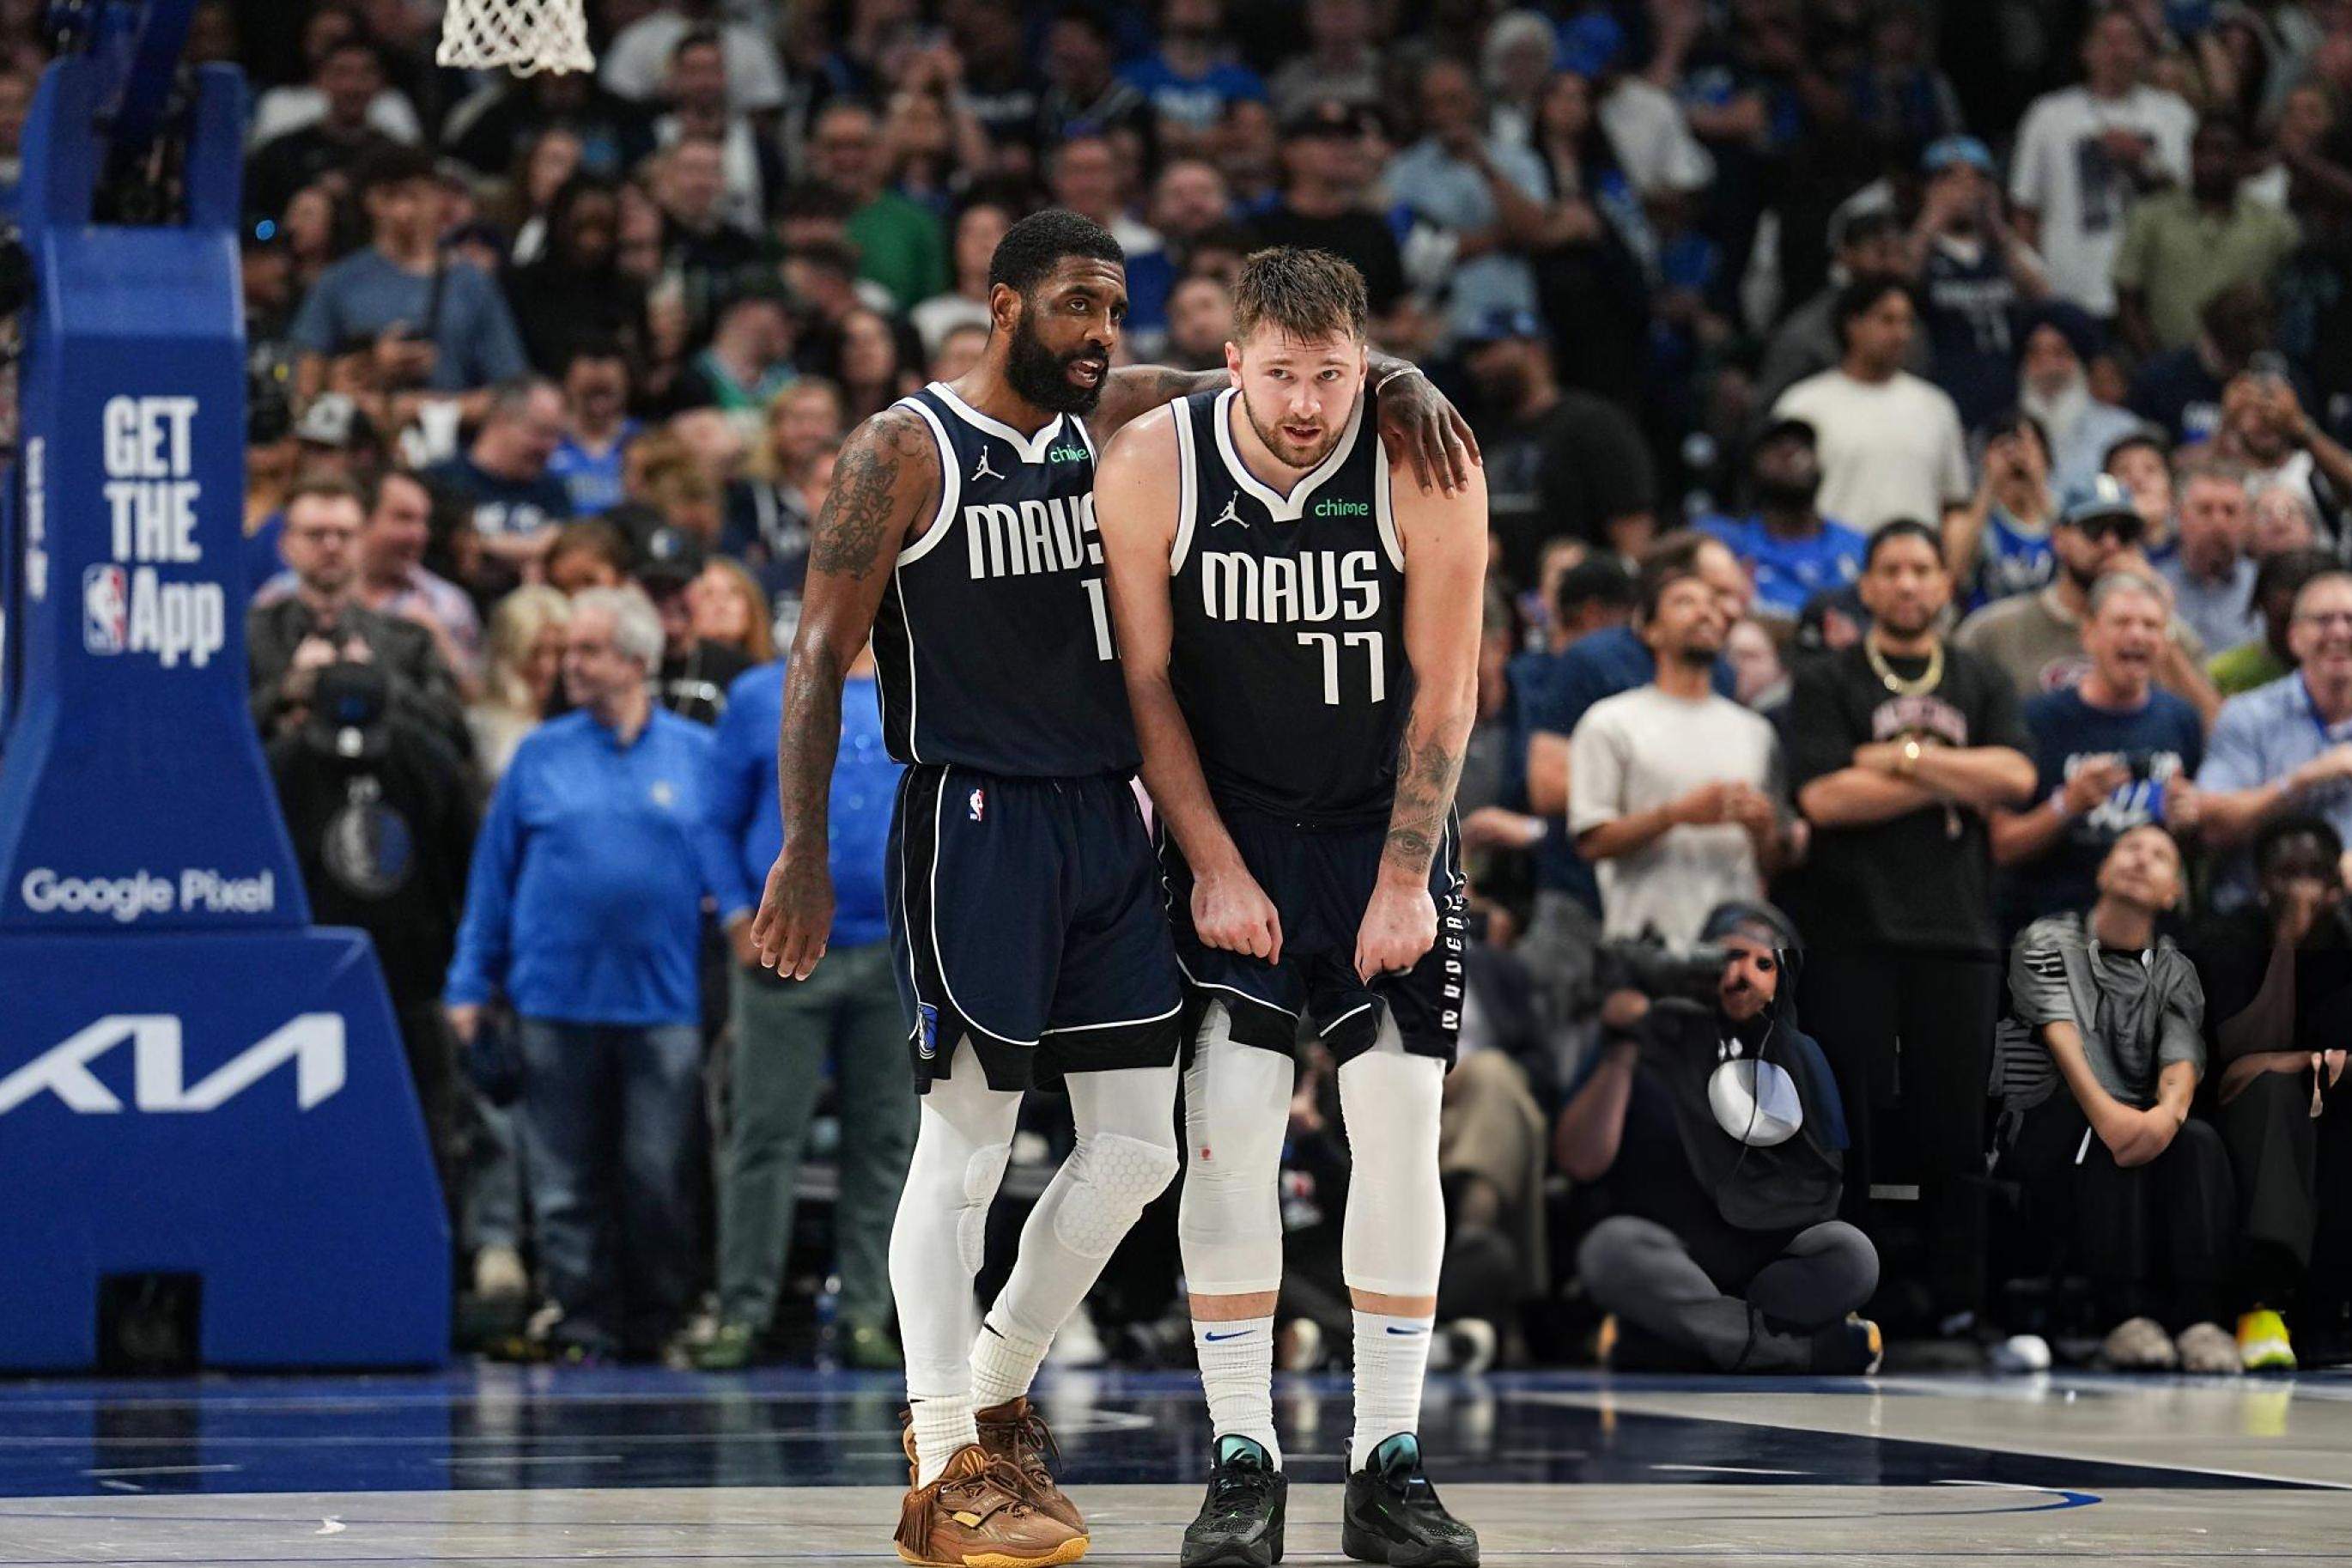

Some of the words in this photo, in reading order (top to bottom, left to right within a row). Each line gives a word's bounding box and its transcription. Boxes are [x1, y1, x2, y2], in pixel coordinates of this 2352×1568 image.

[103, 395, 198, 478] GET
[103, 482, 202, 563] THE
[1315, 498, 1369, 516] chime
[130, 566, 225, 668] App
[1080, 577, 1121, 661] 1
[1202, 550, 1381, 623] MAVS
[1297, 631, 1385, 705] 77
[21, 867, 174, 923] Google
[180, 868, 275, 913] Pixel
[0, 1013, 345, 1114] KIA
